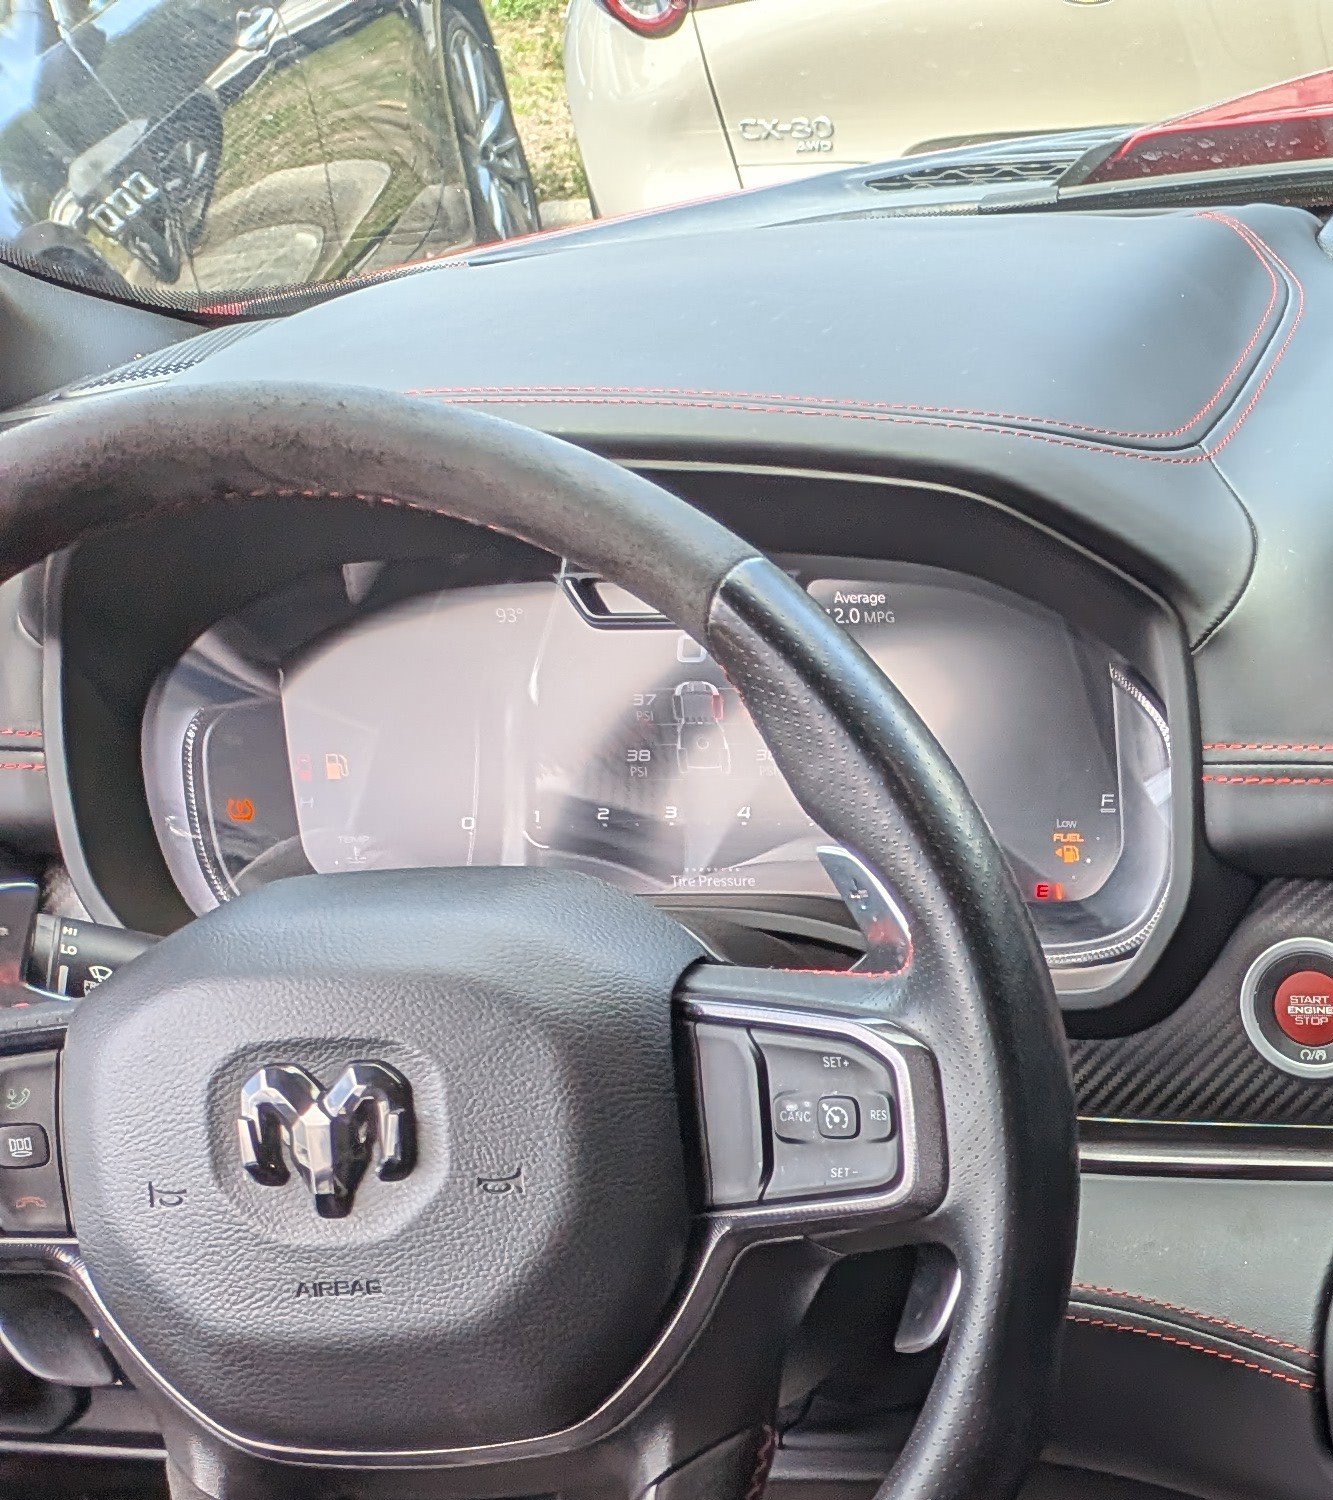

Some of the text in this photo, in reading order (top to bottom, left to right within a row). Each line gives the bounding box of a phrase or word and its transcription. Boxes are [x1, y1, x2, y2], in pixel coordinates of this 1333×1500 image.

[797, 141, 833, 153] AWD
[834, 591, 886, 606] Average
[495, 607, 524, 623] 93°
[864, 611, 895, 623] MPG
[633, 694, 657, 706] 37
[636, 711, 654, 721] PSI
[627, 750, 651, 762] 38
[630, 767, 648, 777] PSI
[1101, 794, 1115, 806] F
[597, 808, 610, 820] 2
[664, 805, 678, 819] 3
[736, 806, 751, 819] 4
[1056, 818, 1077, 828] Low
[1053, 833, 1085, 843] FUEL
[671, 874, 756, 888] Tire Pressure
[1036, 884, 1050, 898] E
[62, 926, 78, 937] HI
[60, 944, 78, 956] LO
[1289, 995, 1329, 1004] START
[1294, 1016, 1329, 1026] STOP
[779, 1111, 812, 1123] CANC
[870, 1110, 887, 1121] RES
[295, 1279, 383, 1298] AIRBAG
